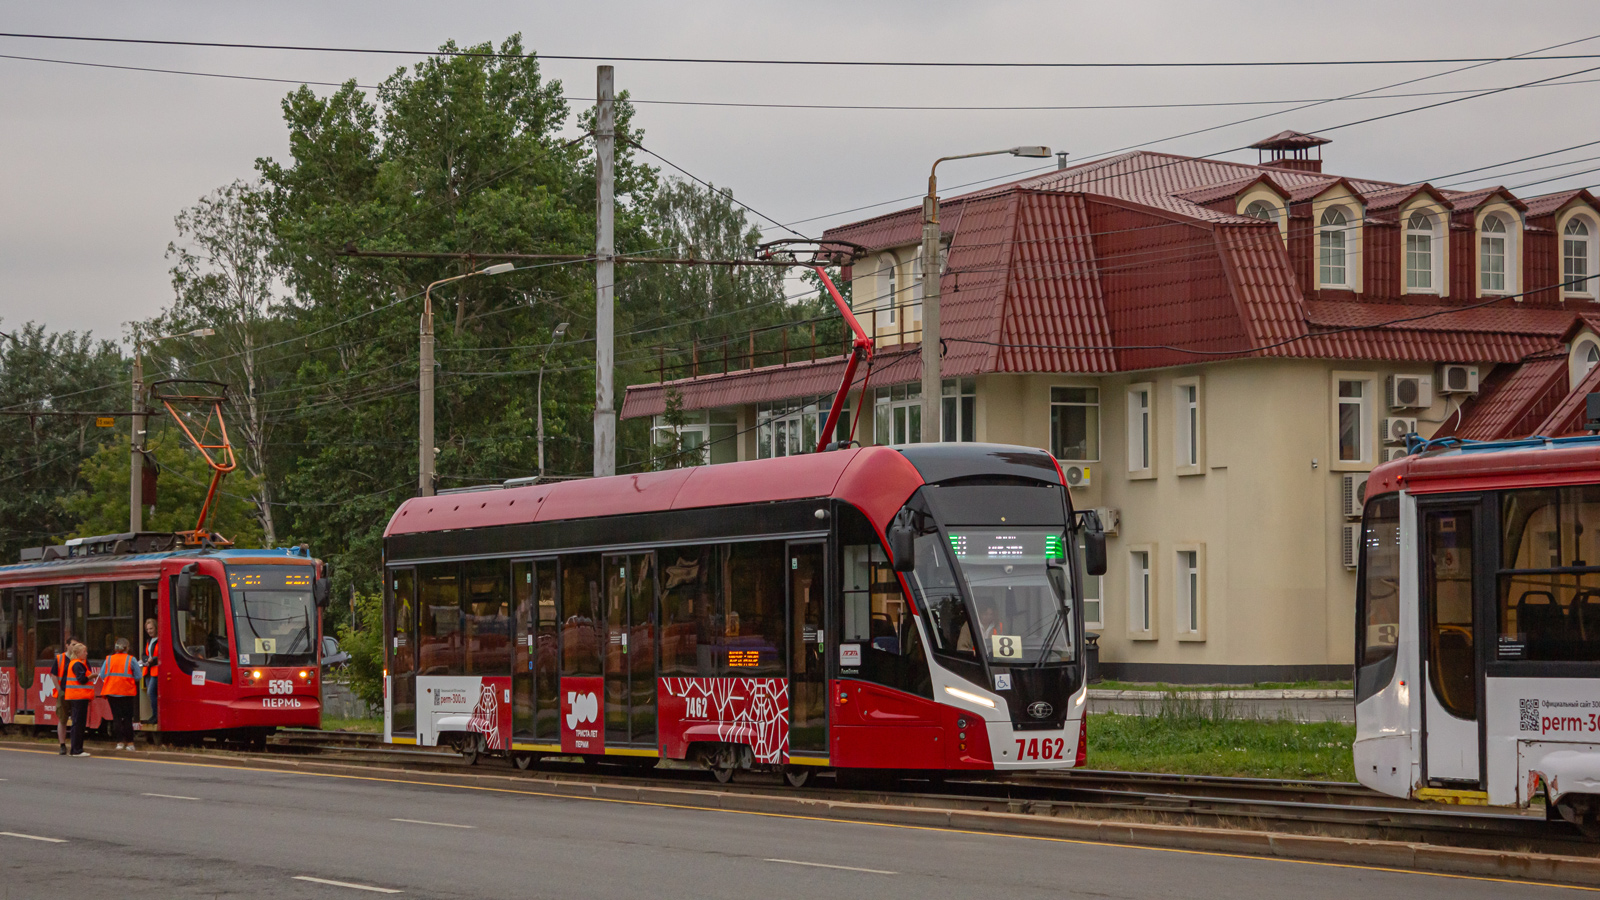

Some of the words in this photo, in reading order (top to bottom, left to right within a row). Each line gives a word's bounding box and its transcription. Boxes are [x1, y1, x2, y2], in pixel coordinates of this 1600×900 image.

[38, 594, 50, 610] 536
[262, 640, 271, 651] 6
[999, 636, 1015, 657] 8
[268, 679, 294, 695] 536
[262, 698, 302, 708] ПЕРМЬ
[440, 693, 467, 706] perm-300.ru
[685, 697, 708, 718] 7462
[1542, 699, 1579, 709] Официальный
[1579, 700, 1591, 708] сайт
[566, 691, 598, 730] 300
[1015, 737, 1065, 761] 7462
